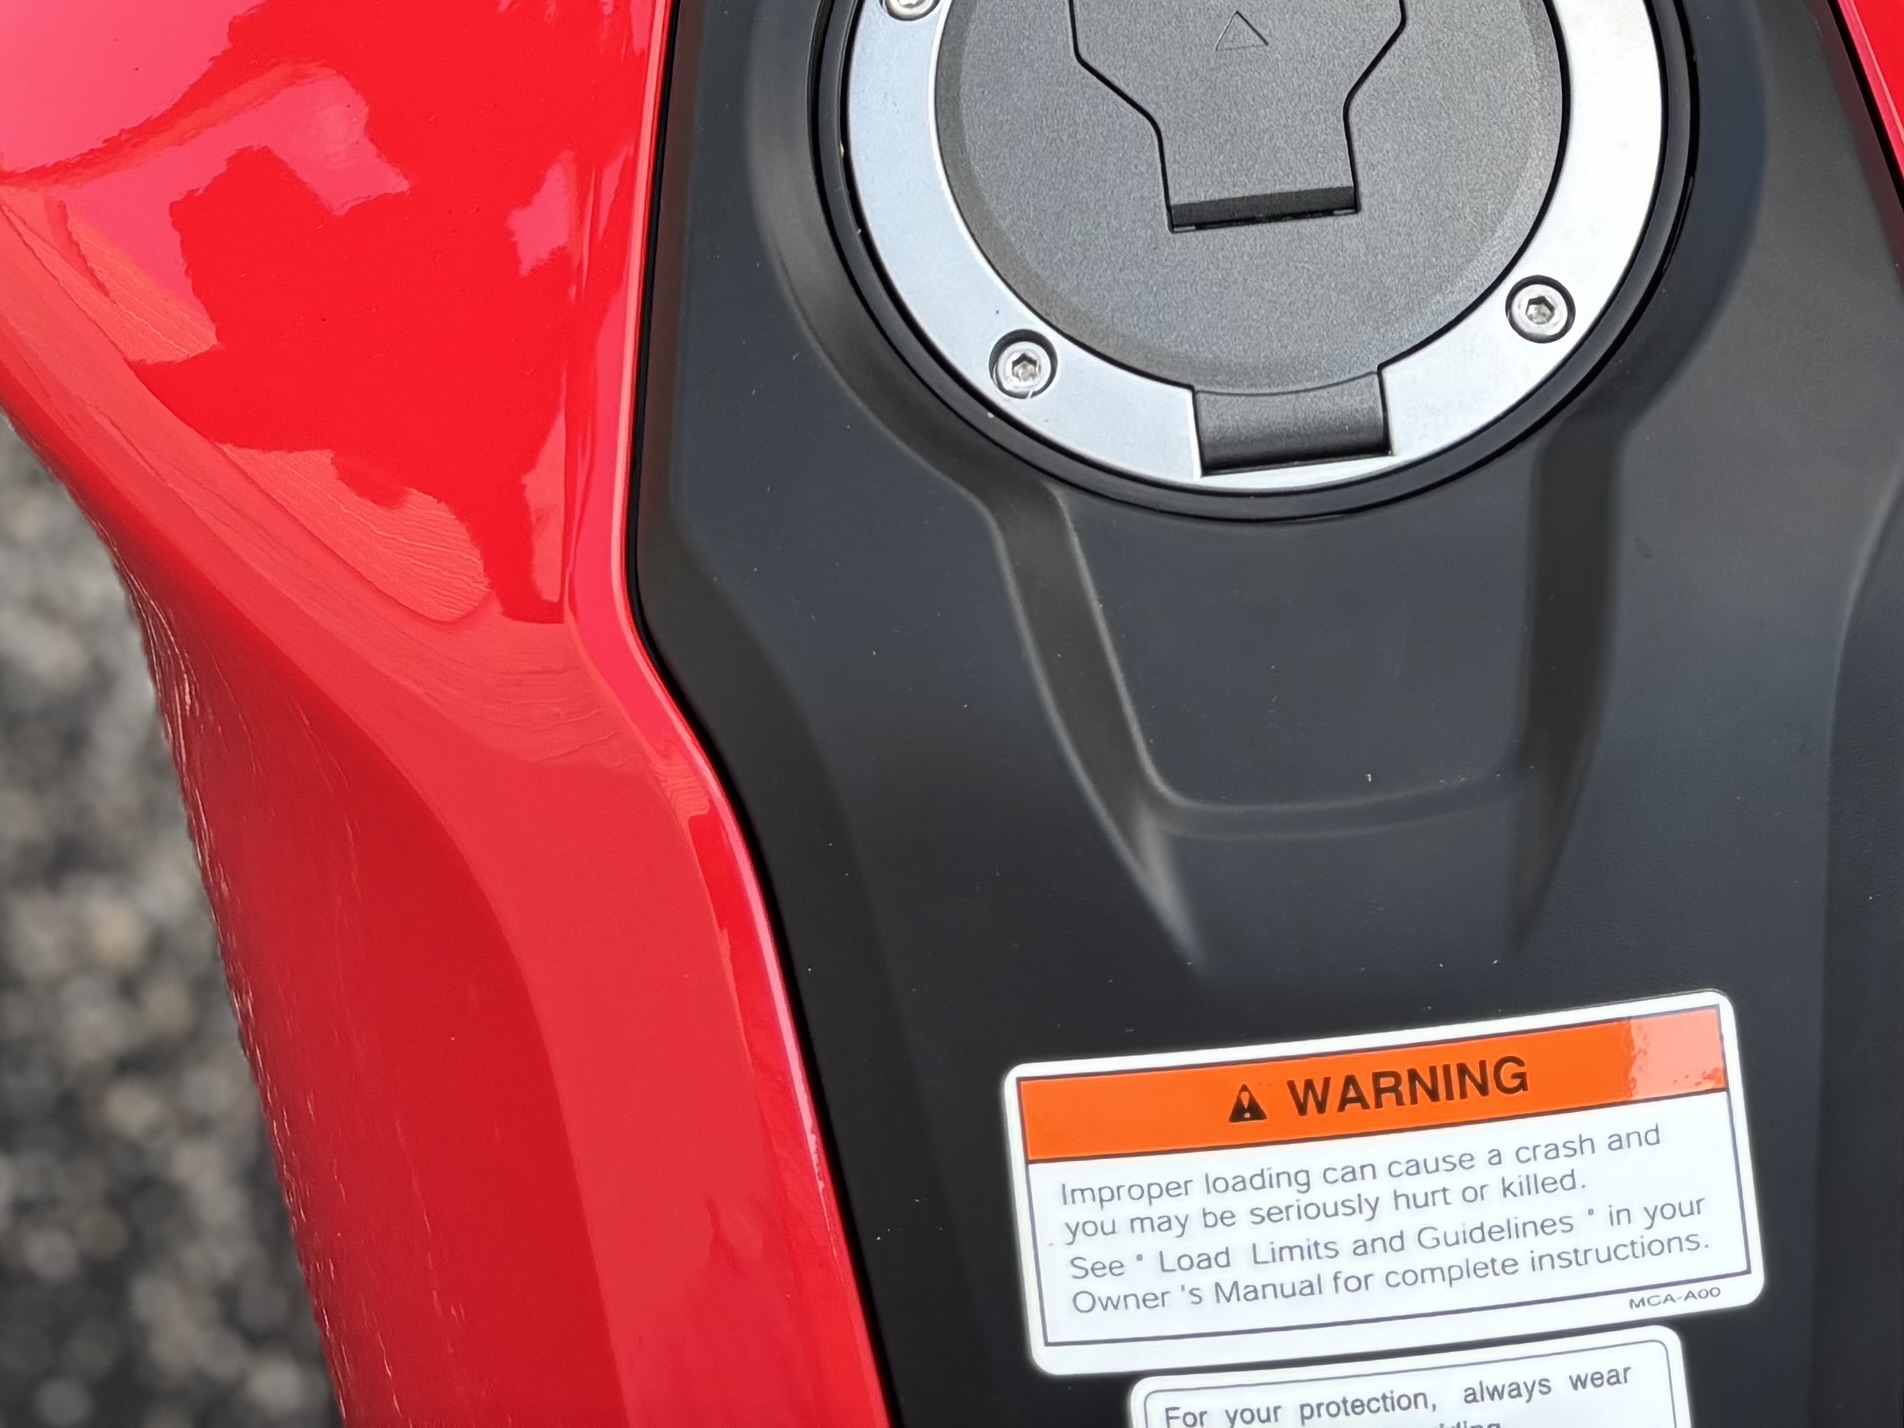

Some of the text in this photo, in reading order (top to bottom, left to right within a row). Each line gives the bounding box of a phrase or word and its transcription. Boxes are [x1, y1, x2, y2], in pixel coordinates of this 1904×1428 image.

[1286, 1055, 1529, 1117] WARNING
[1061, 1122, 1661, 1210] Improper loading can cause a crash and
[1064, 1168, 1586, 1246] you may be seriously hurt or killed.
[1069, 1256, 1125, 1280] See
[1158, 1246, 1231, 1273] Load
[1251, 1240, 1340, 1265] Limits
[1352, 1229, 1405, 1257] and
[1417, 1215, 1575, 1250] Guidelines
[1608, 1204, 1632, 1227] in
[1643, 1197, 1705, 1231] your
[1214, 1273, 1323, 1304] Manual
[1332, 1270, 1375, 1294] for
[1384, 1256, 1519, 1289] complete
[1529, 1233, 1709, 1273] instructions.
[1164, 1366, 1632, 1428] For your protection, always wear
